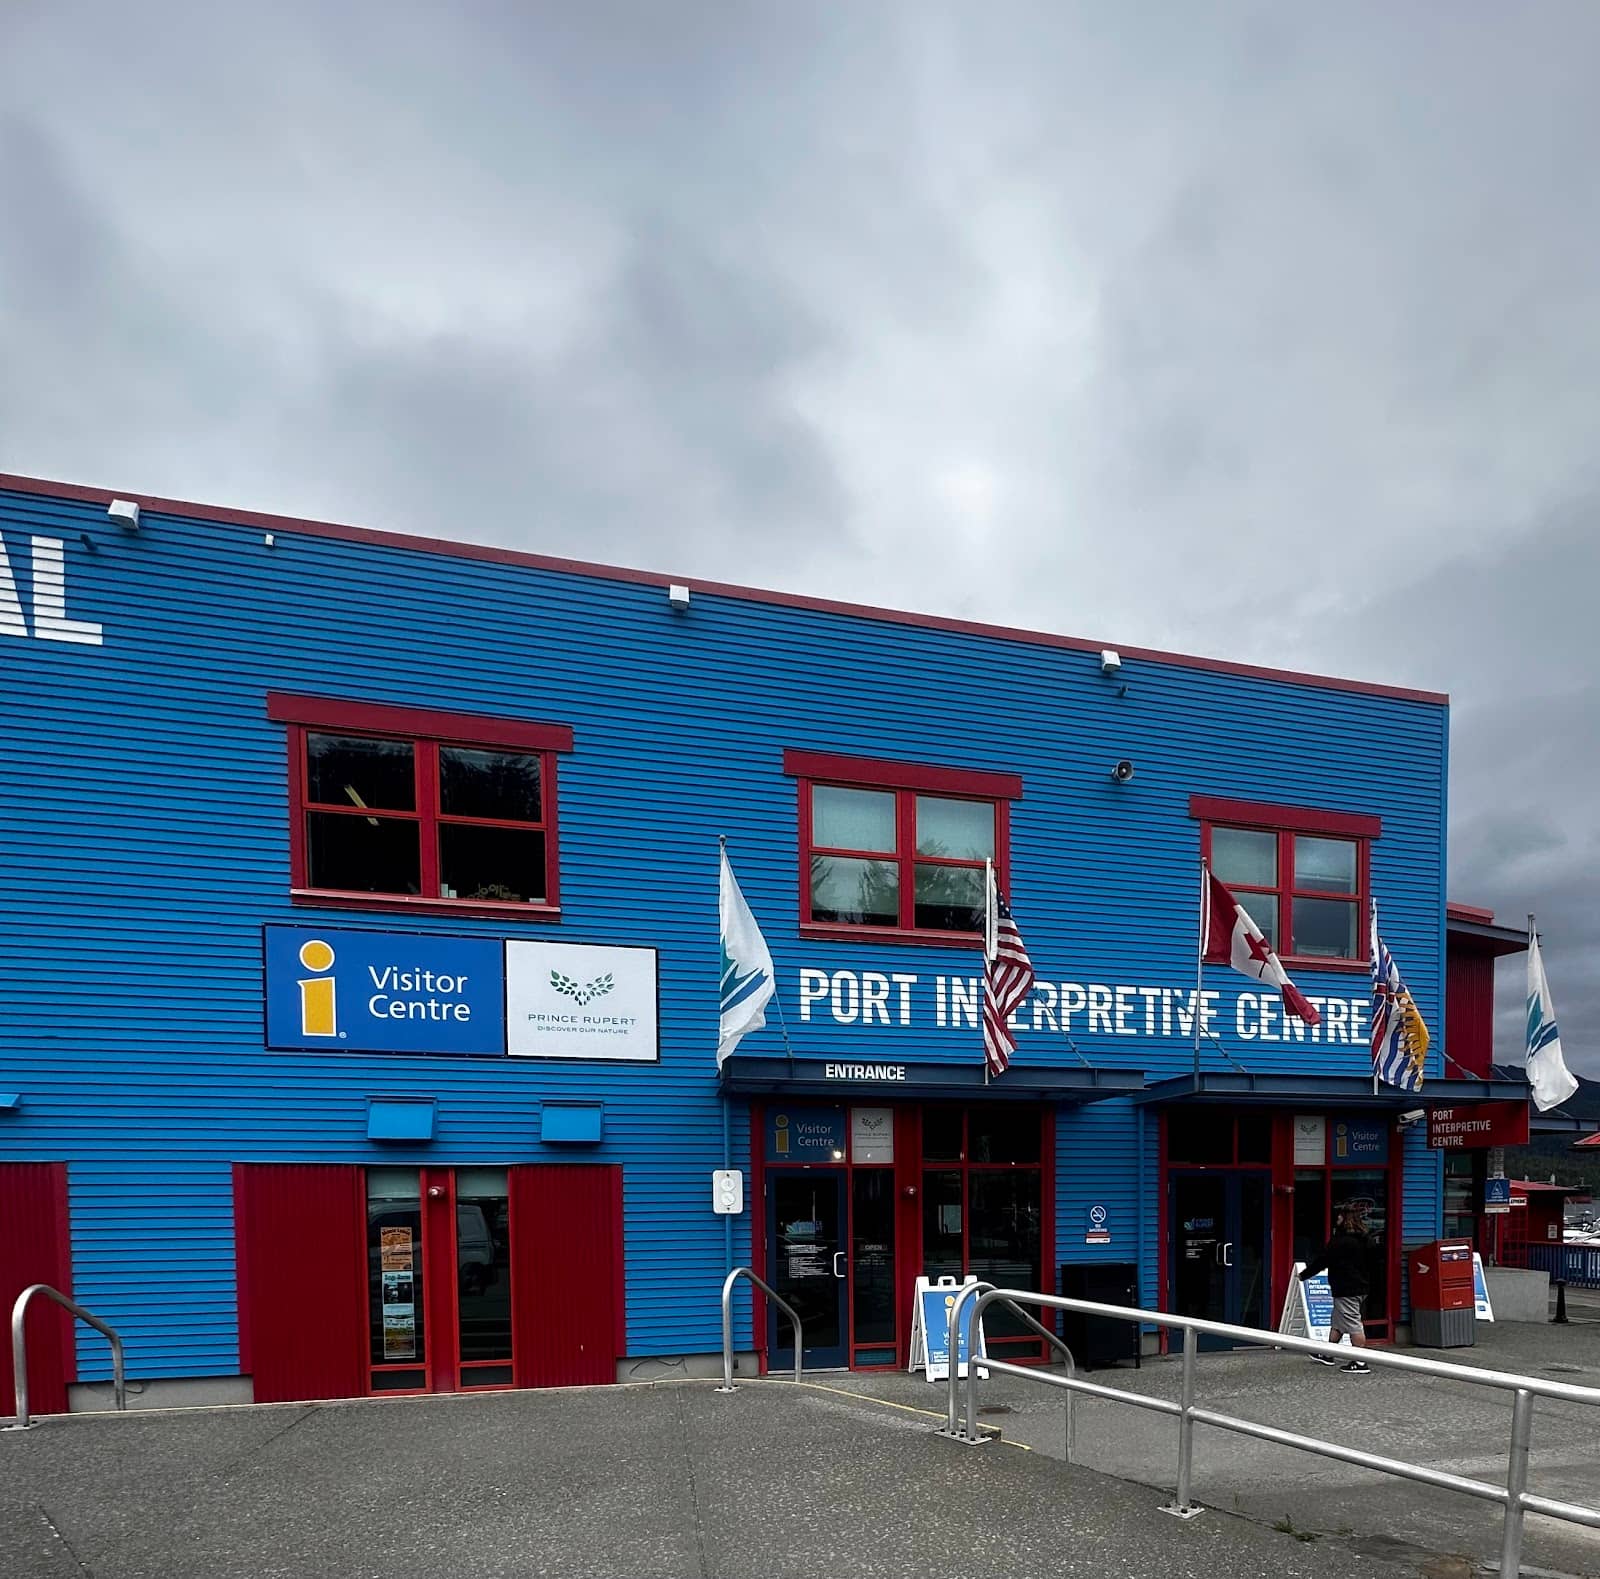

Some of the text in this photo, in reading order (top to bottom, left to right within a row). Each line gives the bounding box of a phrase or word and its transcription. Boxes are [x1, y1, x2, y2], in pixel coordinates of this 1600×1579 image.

[368, 965, 469, 994] Visitor
[368, 995, 471, 1022] Centre
[799, 968, 918, 1026] PORT
[936, 975, 1221, 1038] INRPRETIVE
[528, 1013, 637, 1026] PRINCE RUPERT
[537, 1025, 577, 1033] DISCOVER
[825, 1063, 906, 1081] ENTRANCE
[1432, 1110, 1454, 1121] PORT
[796, 1123, 833, 1135] Visitor
[1432, 1119, 1492, 1134] INTERPRETIVE
[797, 1136, 835, 1147] Centre
[1352, 1131, 1378, 1141] Visitor
[1432, 1136, 1464, 1147] CENTRE
[1352, 1142, 1381, 1152] Centre
